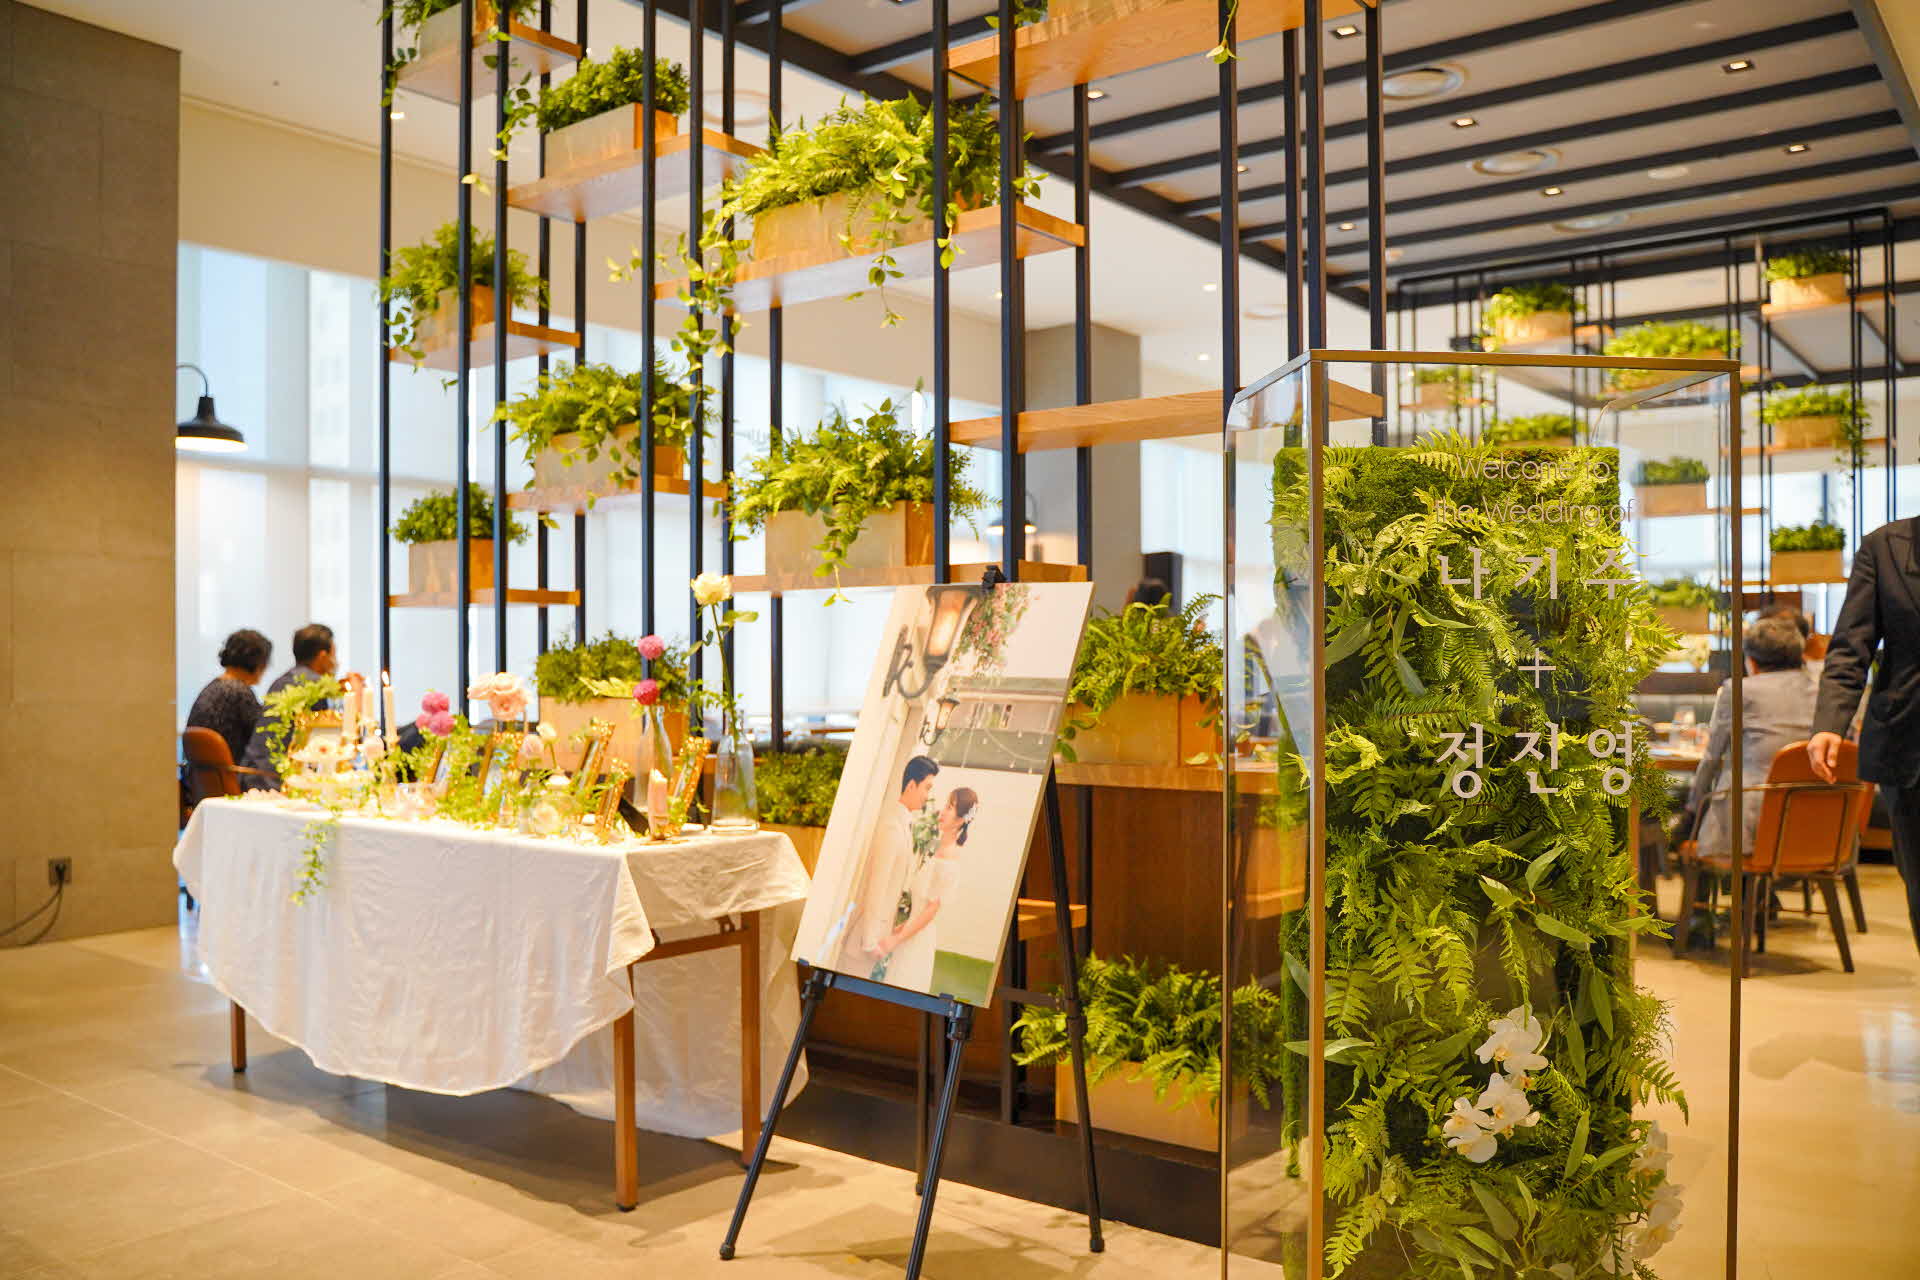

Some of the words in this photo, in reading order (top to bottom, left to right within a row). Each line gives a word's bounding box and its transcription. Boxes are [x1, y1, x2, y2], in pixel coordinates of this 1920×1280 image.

[1456, 452, 1577, 480] Welcome
[1584, 455, 1611, 480] to
[1434, 496, 1475, 524] the
[1482, 496, 1601, 528] Wedding
[1609, 498, 1635, 524] of
